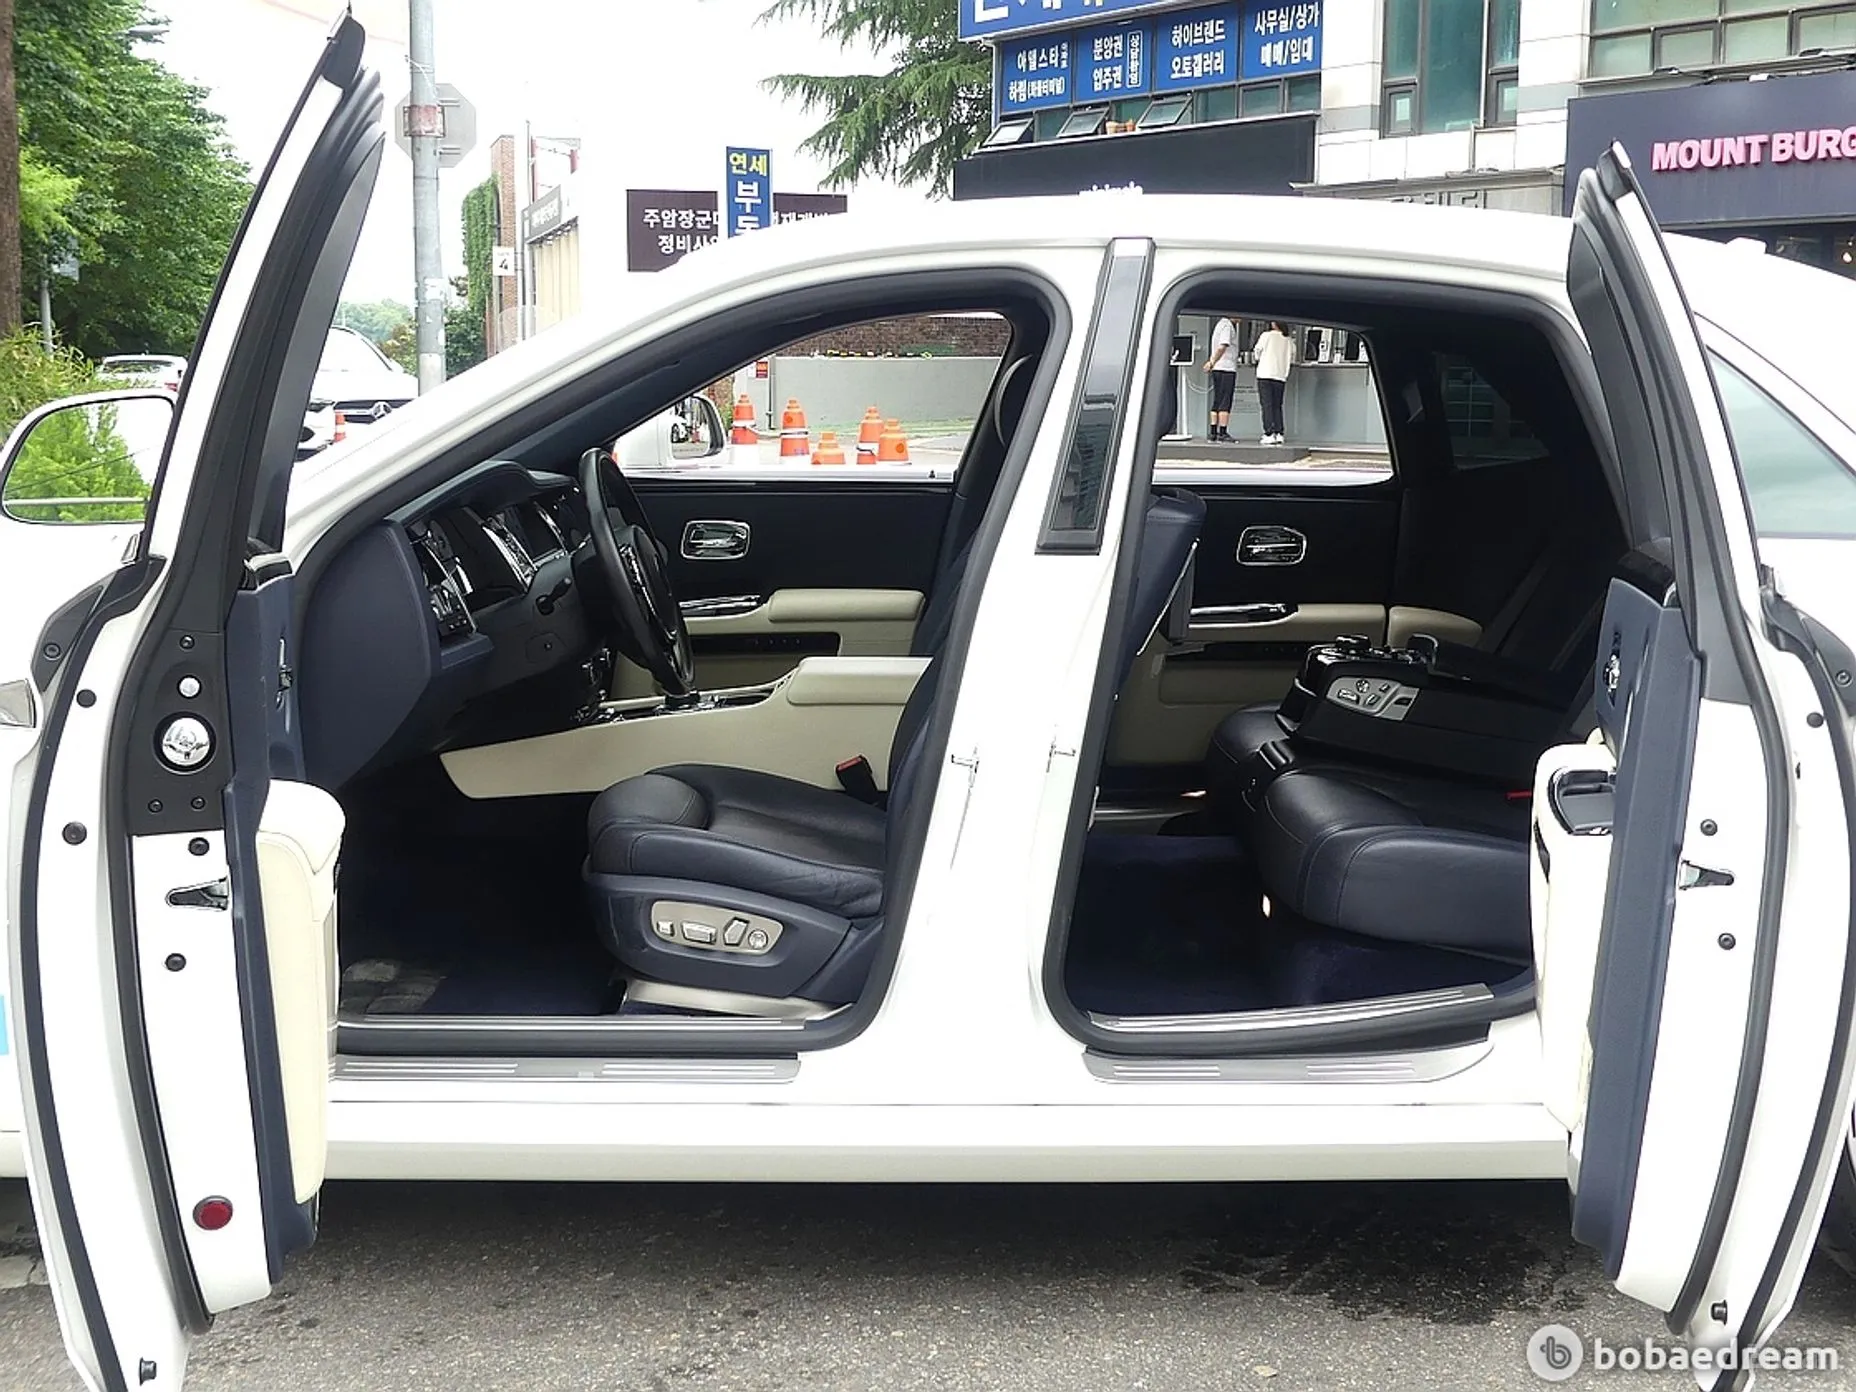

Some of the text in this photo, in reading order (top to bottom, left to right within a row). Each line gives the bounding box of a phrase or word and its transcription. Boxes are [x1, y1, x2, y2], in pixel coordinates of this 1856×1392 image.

[1254, 1, 1320, 36] 사무실/상가
[1093, 34, 1123, 61] 분양권
[1171, 19, 1226, 48] 하이브랜드
[1170, 49, 1225, 79] 오토갤러리
[1260, 36, 1314, 68] 매매/임대
[1092, 65, 1122, 93] 입주권
[729, 152, 768, 177] 연세
[1651, 134, 1769, 172] MOUNT
